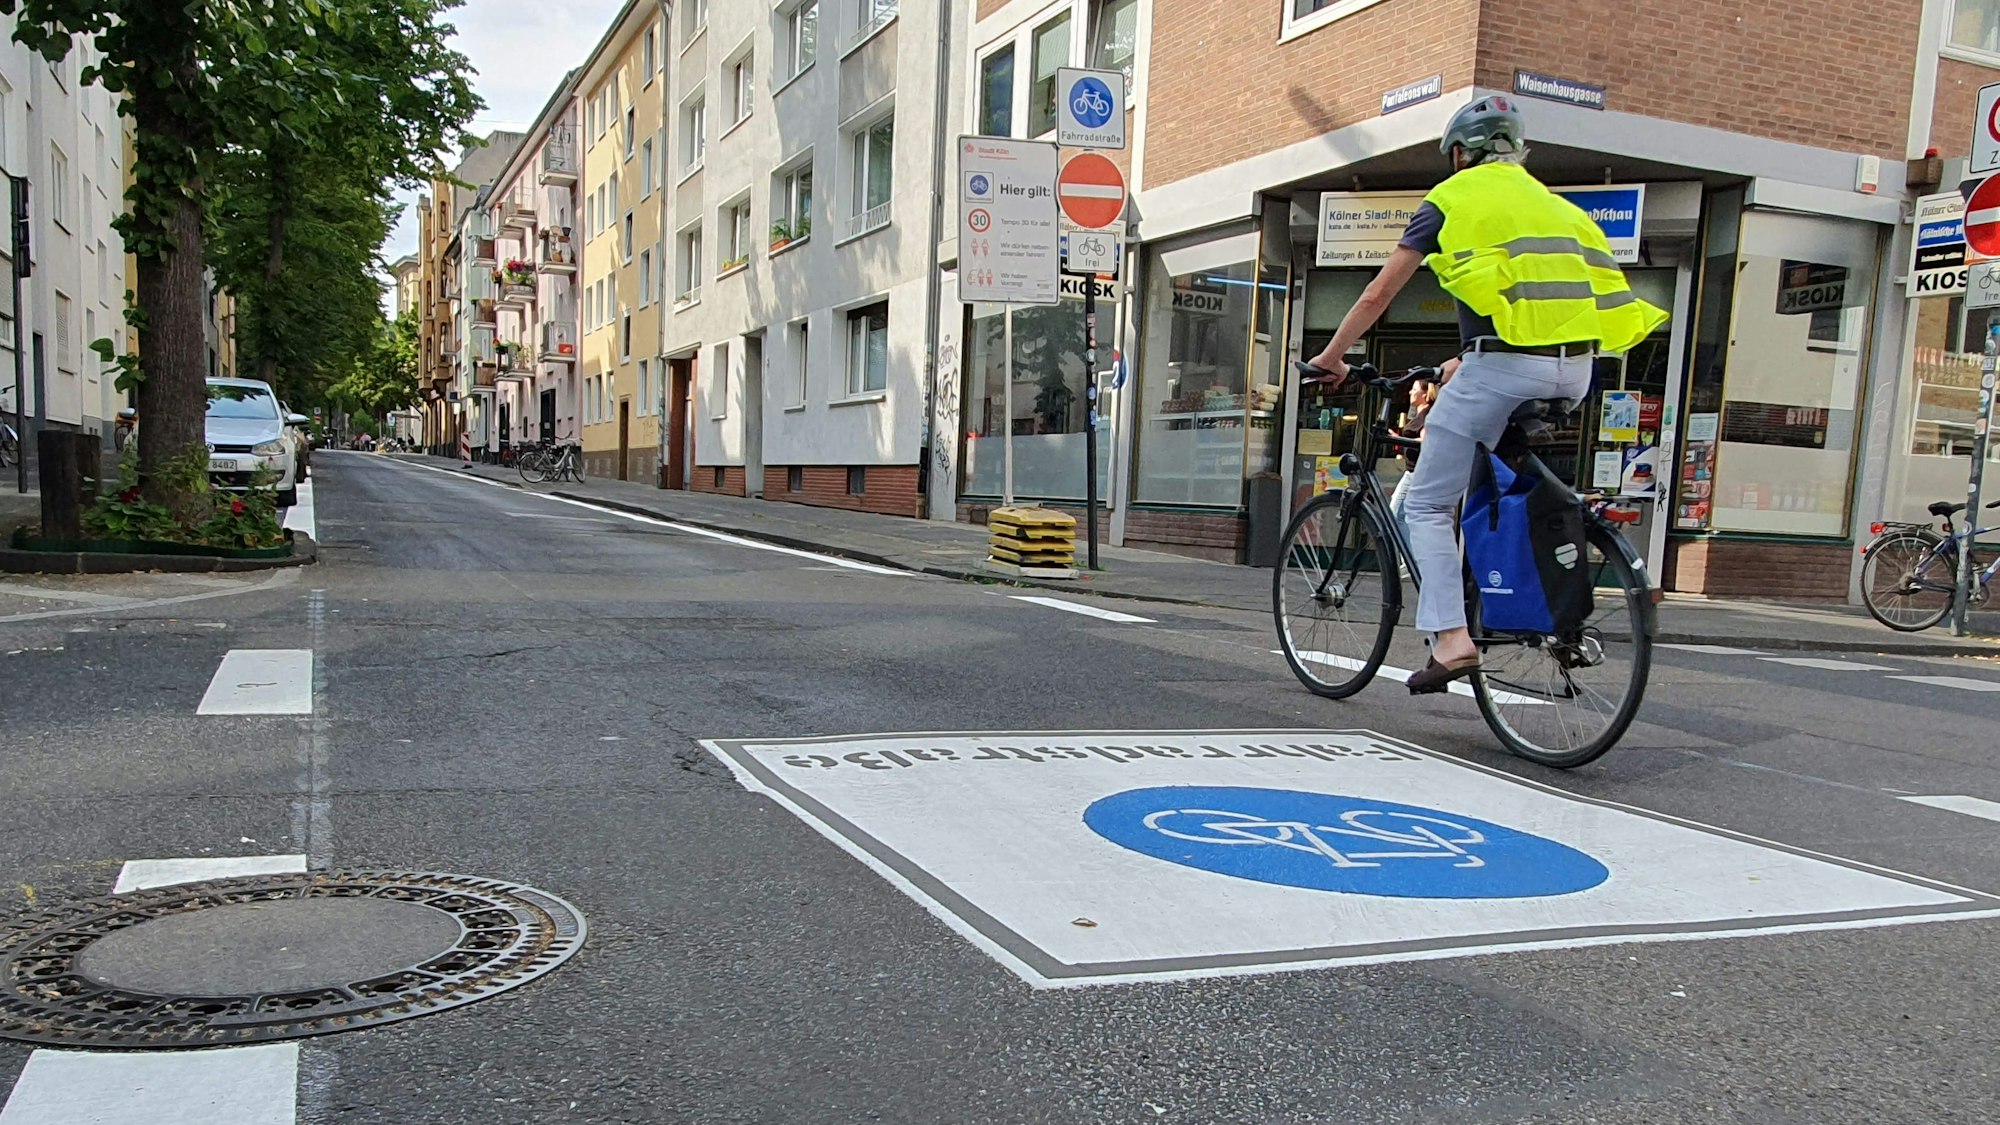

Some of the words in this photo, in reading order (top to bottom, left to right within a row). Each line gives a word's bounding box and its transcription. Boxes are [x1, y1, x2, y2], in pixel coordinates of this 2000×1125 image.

[1518, 73, 1602, 104] Waisenhausgasse
[1061, 131, 1121, 144] Fahrradstraße
[1000, 183, 1025, 196] Hier
[1028, 185, 1051, 199] gilt:
[972, 214, 987, 226] 30
[1329, 210, 1362, 221] Kölner
[1364, 209, 1415, 221] Stadt-Anz
[1321, 251, 1355, 260] Zeitungen
[1365, 251, 1393, 259] Zeitsch
[1085, 257, 1100, 268] frei
[1916, 270, 1968, 292] KIOS
[1984, 291, 1999, 301] fre
[782, 743, 1423, 770] Fahrradstraße
